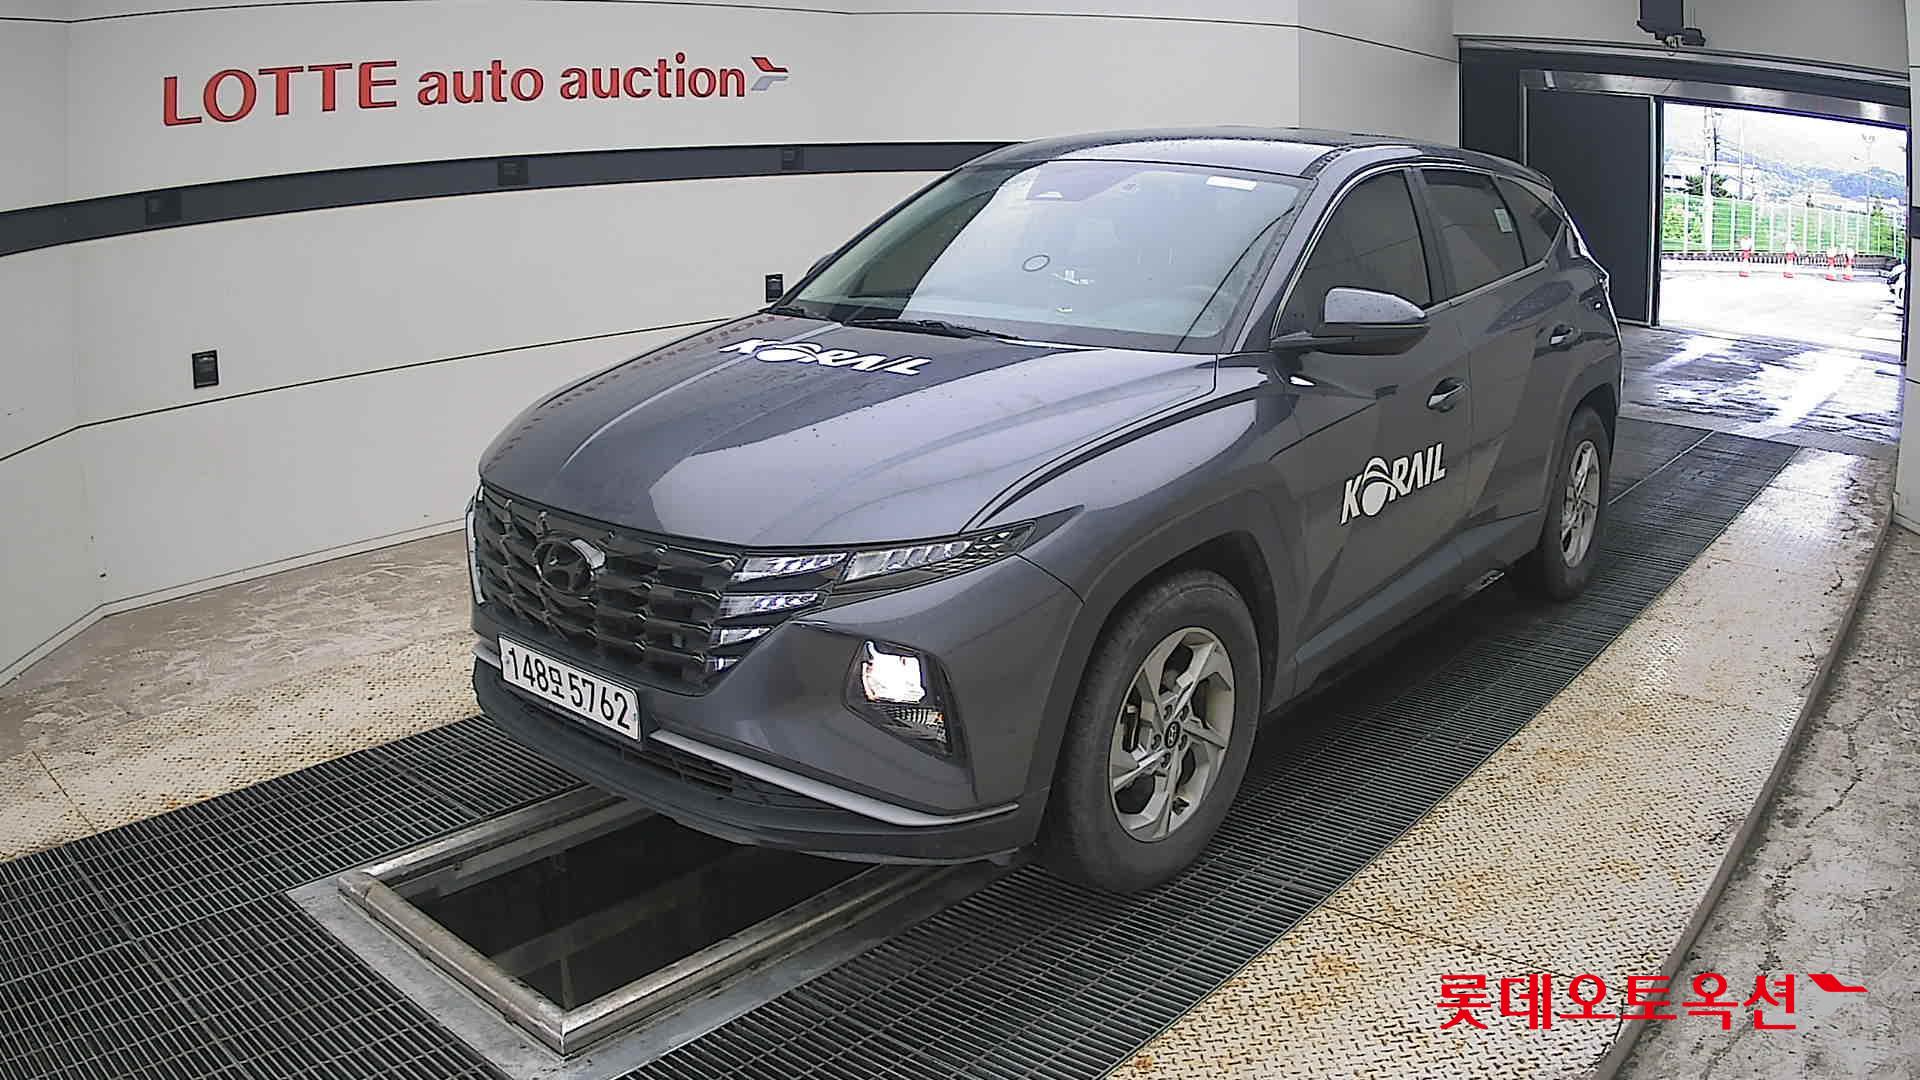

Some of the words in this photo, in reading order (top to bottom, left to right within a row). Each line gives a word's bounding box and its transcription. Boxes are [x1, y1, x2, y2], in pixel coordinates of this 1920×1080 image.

[163, 61, 397, 126] LOTTE
[417, 60, 544, 105] auto
[559, 52, 746, 100] auction
[1340, 442, 1447, 525] KORAIL
